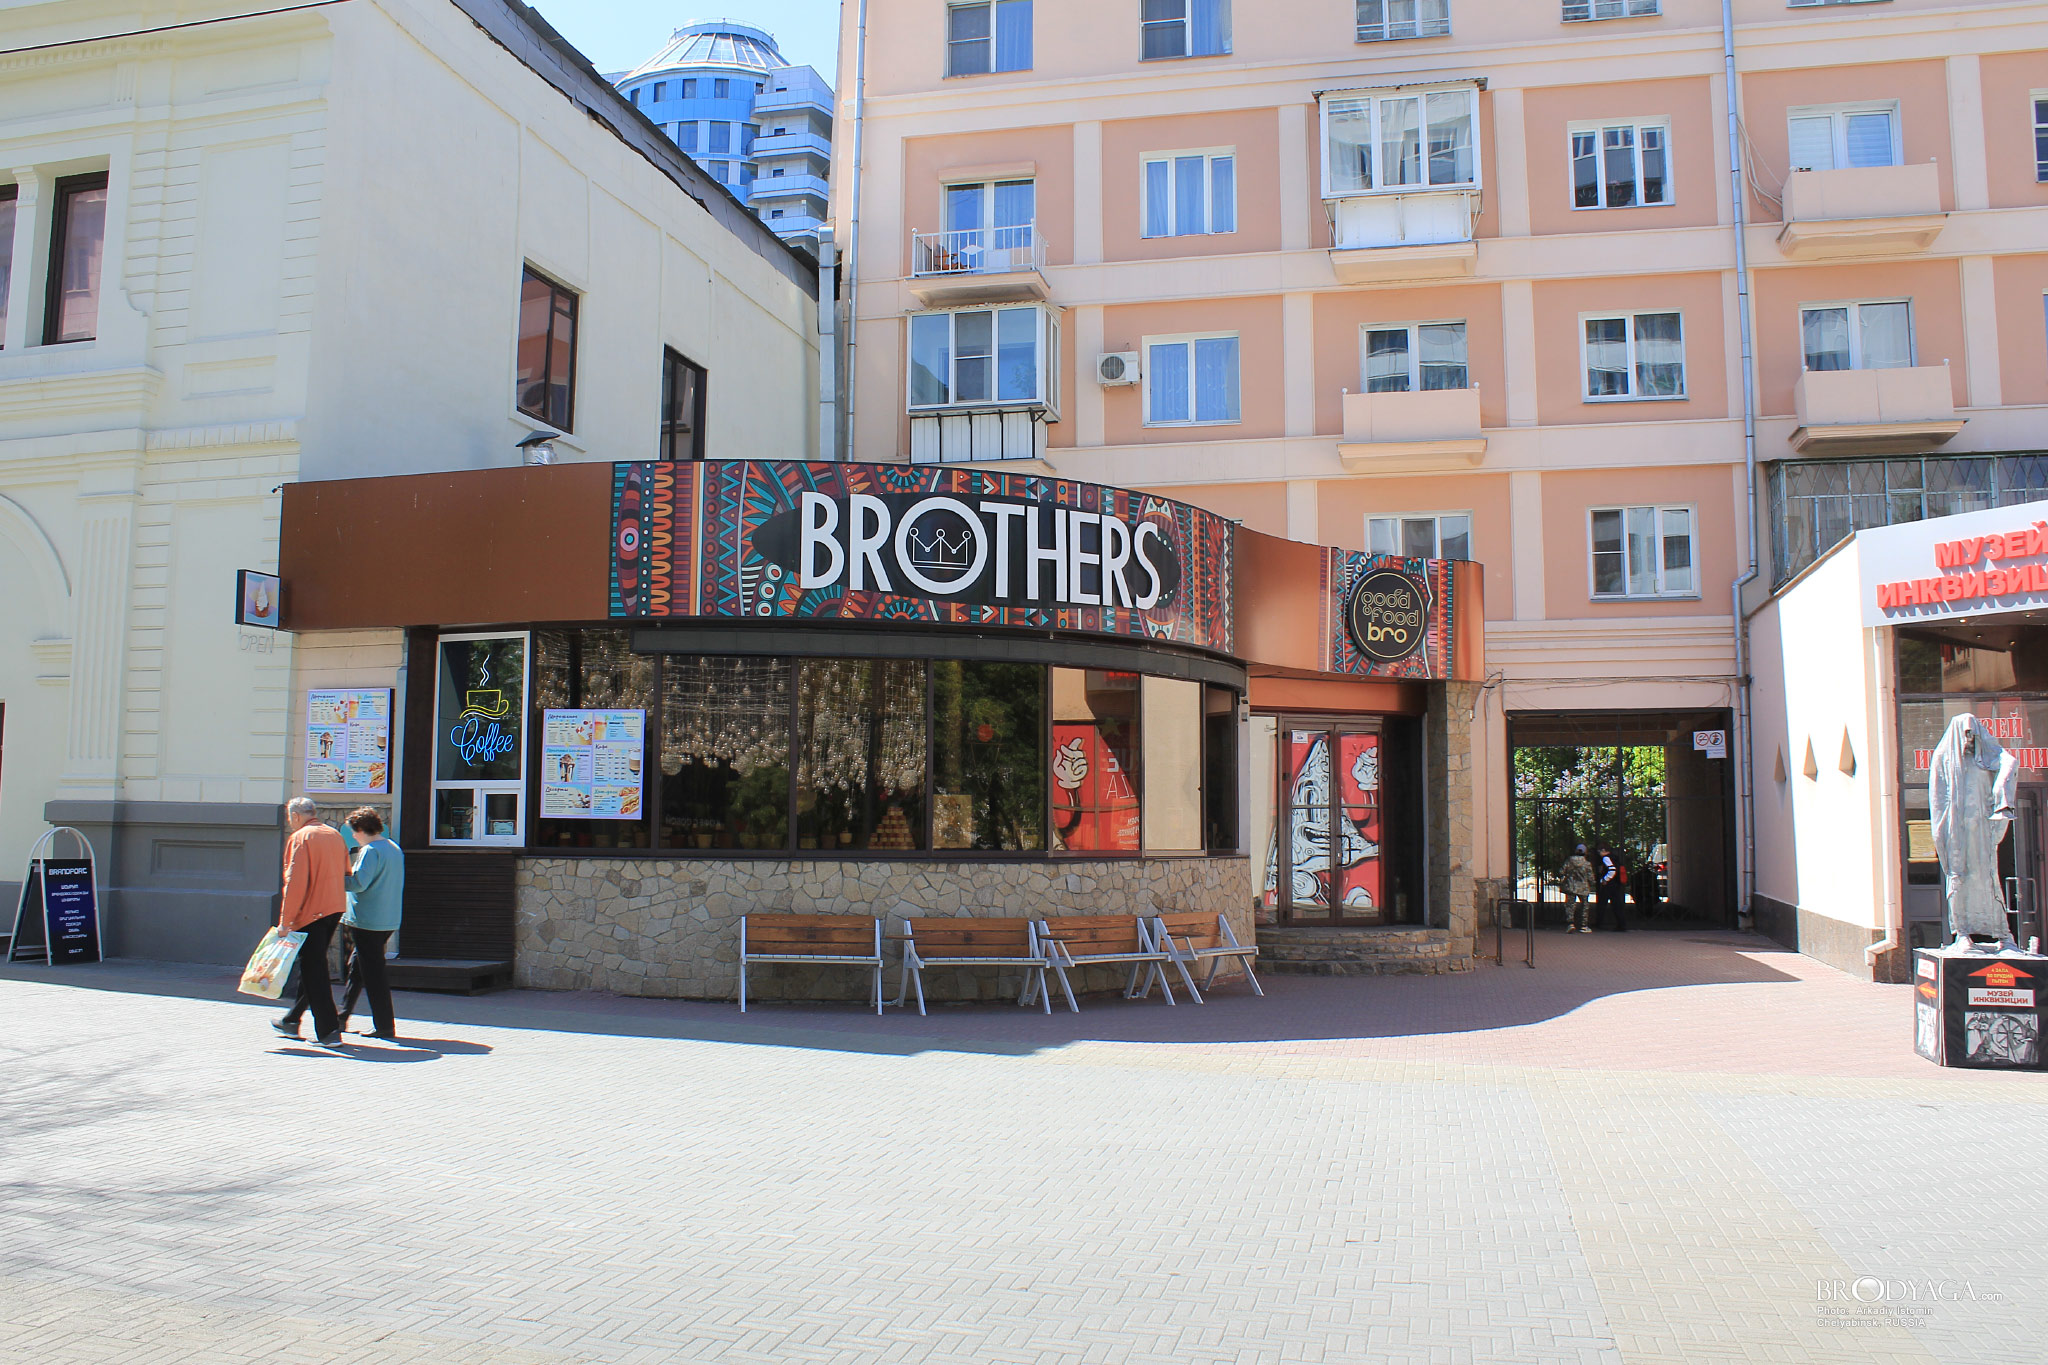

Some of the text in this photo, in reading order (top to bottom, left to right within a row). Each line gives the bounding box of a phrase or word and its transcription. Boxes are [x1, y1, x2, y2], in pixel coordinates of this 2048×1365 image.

[799, 491, 1161, 611] BROTHERS
[1934, 521, 2048, 568] МУЗЕЙ
[1361, 590, 1410, 616] good
[1372, 607, 1418, 627] food
[240, 634, 274, 654] OPEN
[1368, 622, 1407, 644] bro
[450, 718, 514, 766] Coffee
